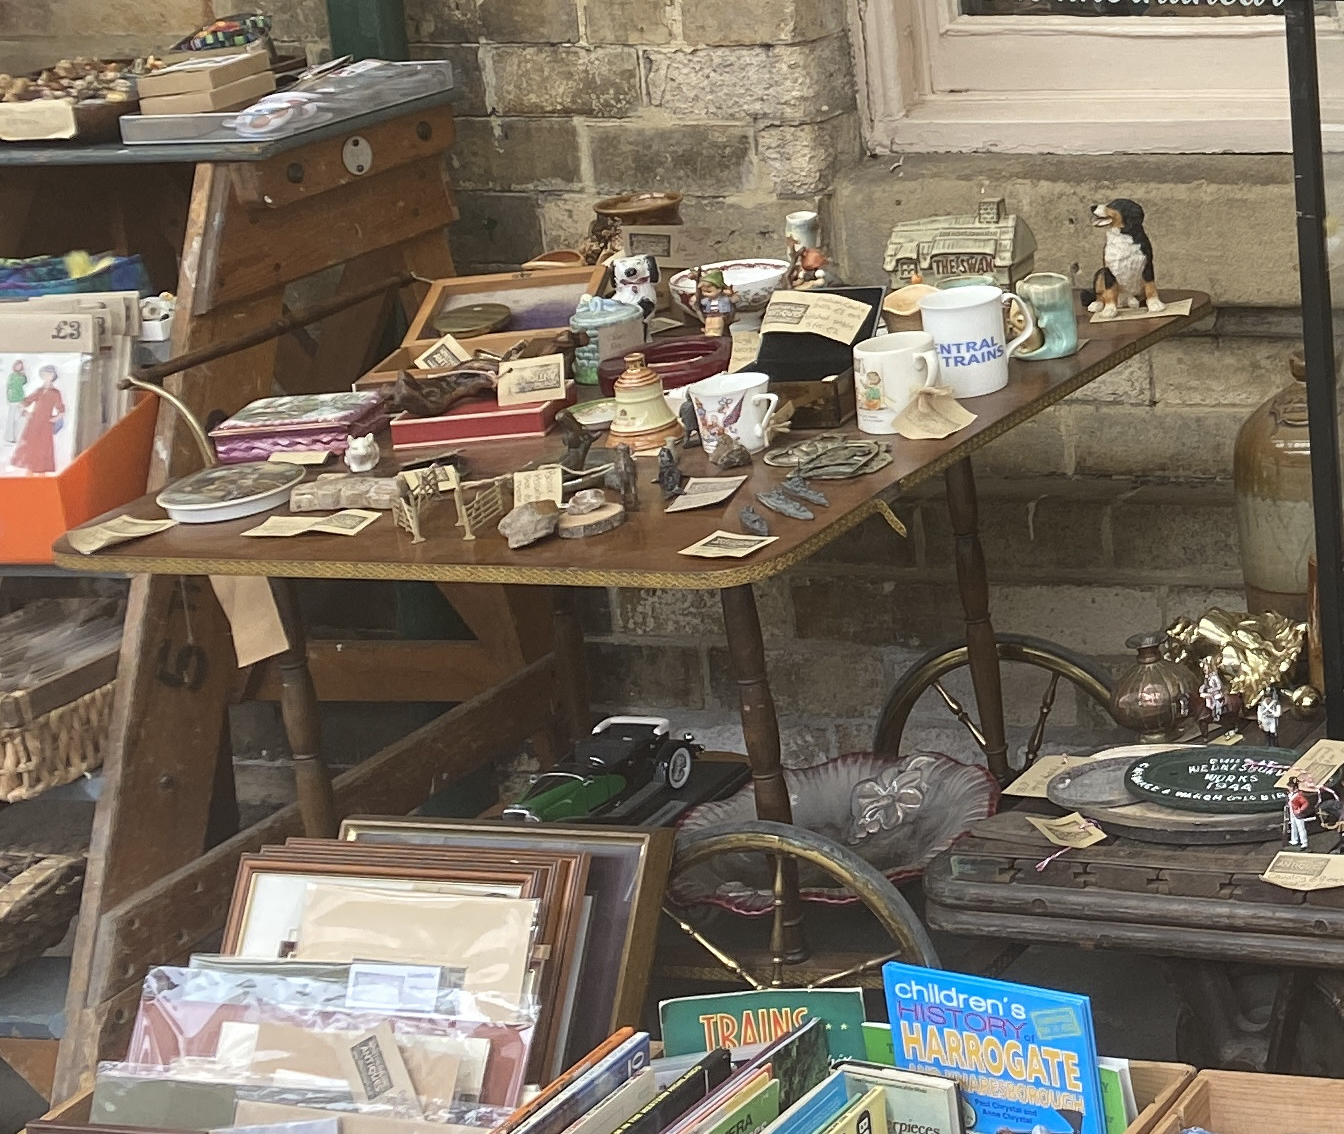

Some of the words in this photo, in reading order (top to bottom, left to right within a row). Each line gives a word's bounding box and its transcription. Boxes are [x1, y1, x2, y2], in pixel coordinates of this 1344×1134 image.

[932, 256, 957, 275] THE
[960, 254, 995, 274] SWAN
[51, 320, 81, 340] £3
[942, 346, 1005, 368] TRAINS
[1204, 774, 1259, 783] WORKS
[1206, 782, 1252, 792] 1944
[895, 979, 1027, 1020] children's
[699, 1006, 809, 1053] TRAINS
[897, 1000, 1028, 1042] HISTORY
[1024, 1034, 1035, 1043] of
[901, 1020, 1083, 1093] HARROGATE
